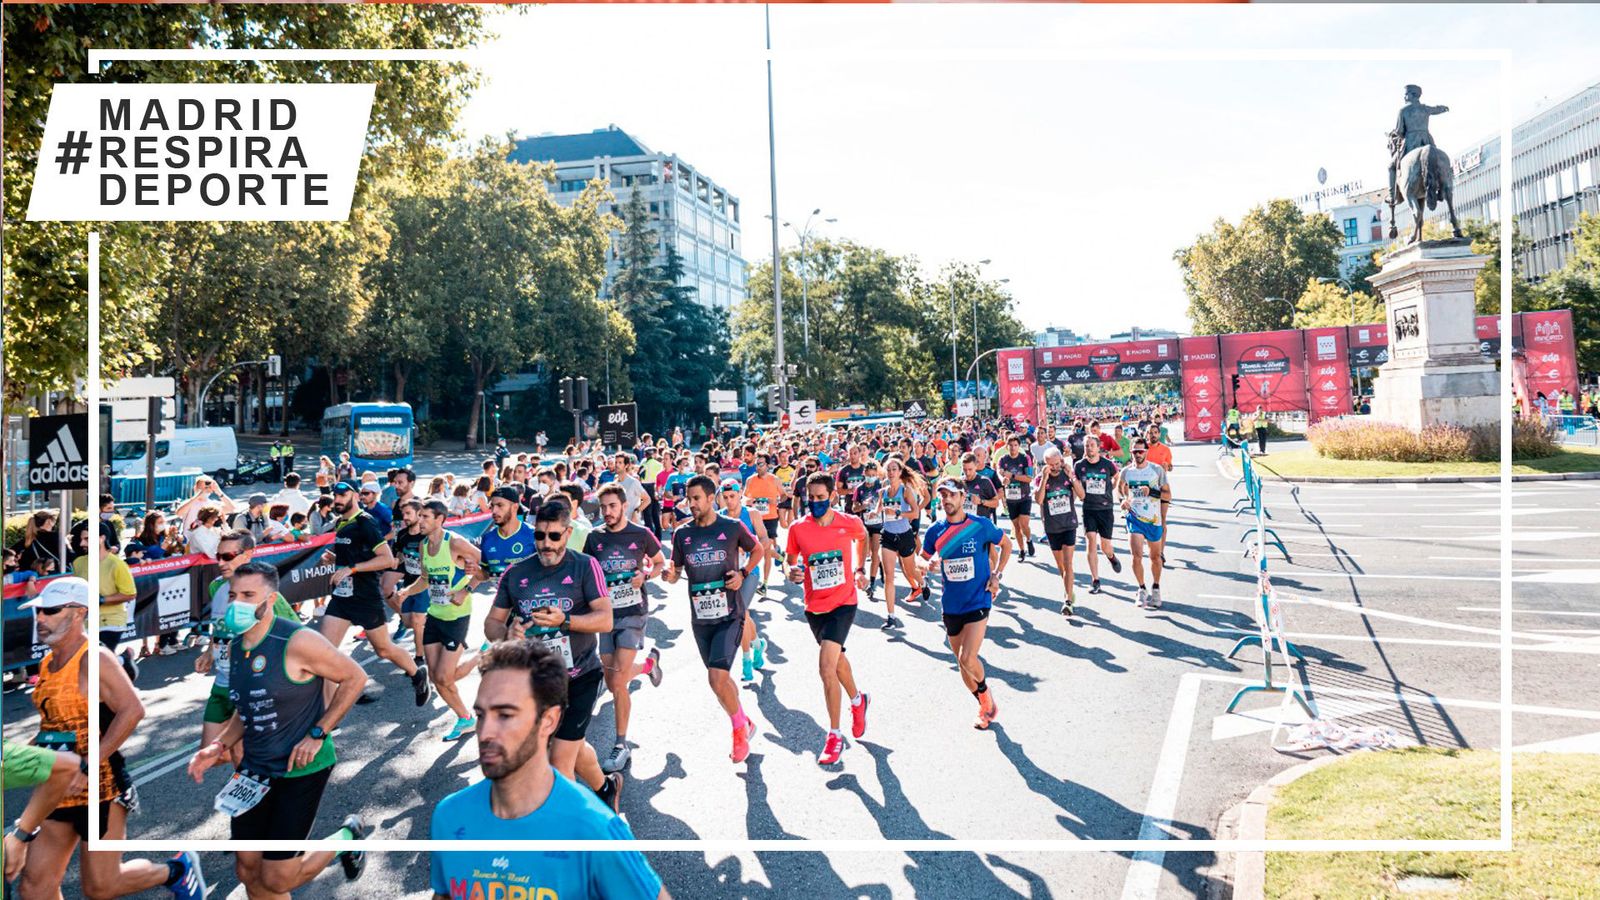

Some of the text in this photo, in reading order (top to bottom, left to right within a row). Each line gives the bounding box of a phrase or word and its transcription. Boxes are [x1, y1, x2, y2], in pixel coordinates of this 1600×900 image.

[1191, 353, 1217, 361] MADRID
[1255, 348, 1269, 359] edp
[1542, 352, 1560, 363] edp
[1075, 369, 1091, 380] edp
[1121, 365, 1136, 377] edp
[1321, 365, 1337, 377] edp
[1193, 374, 1209, 385] edp
[1011, 384, 1025, 395] edp
[608, 409, 629, 427] edp
[30, 461, 88, 485] adidas
[304, 564, 336, 579] MADRI
[817, 567, 838, 580] 20763
[699, 598, 721, 610] 20512
[159, 611, 191, 623] Comunidad
[159, 617, 190, 631] de Madrid
[228, 782, 257, 804] 20901
[491, 855, 510, 871] edp
[472, 869, 498, 879] Rock
[449, 877, 559, 900] MADRID
